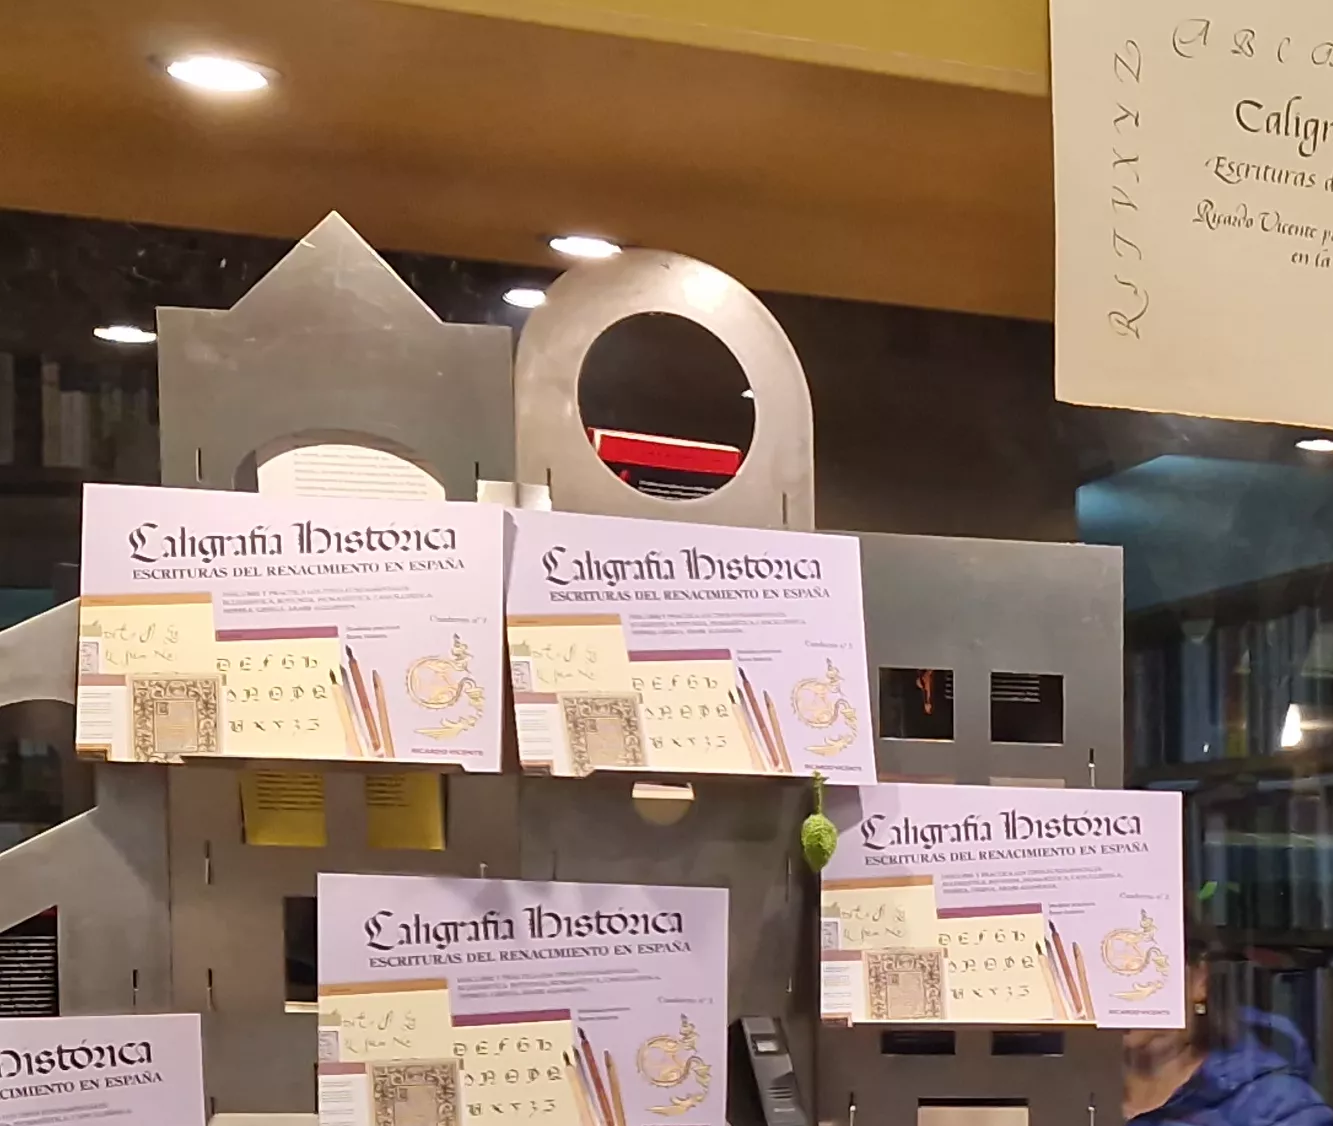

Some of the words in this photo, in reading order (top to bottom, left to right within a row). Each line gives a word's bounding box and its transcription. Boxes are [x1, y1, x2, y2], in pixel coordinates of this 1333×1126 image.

[1205, 157, 1316, 187] Escrituras
[1259, 211, 1317, 238] Vicente
[1291, 252, 1308, 264] en
[1314, 250, 1331, 268] la
[294, 519, 457, 556] Histórica
[133, 565, 228, 580] ESCRITURAS
[233, 565, 262, 579] DEL
[266, 561, 380, 577] RENACIMIENTO
[385, 561, 404, 573] EN
[409, 556, 465, 572] ESPAÑA
[681, 547, 821, 580] Histórica
[550, 589, 631, 602] ESCRITURAS
[635, 589, 660, 601] DEL
[664, 588, 759, 601] RENACIMIENTO
[763, 588, 779, 599] EN
[783, 585, 830, 600] ESPAÑA
[999, 808, 1141, 842] Histórica
[865, 851, 946, 867] ESCRITURAS
[950, 851, 975, 862] DEL
[979, 846, 1076, 861] RENACIMIENTO
[1080, 845, 1097, 856] EN
[1100, 841, 1149, 856] ESPAÑA
[523, 904, 683, 940] Histórica
[369, 952, 463, 968] ESCRITURAS
[466, 950, 495, 964] DEL
[499, 945, 609, 962] RENACIMIENTO
[613, 944, 633, 956] EN
[637, 939, 691, 955] ESPAÑA
[80, 1078, 100, 1092] EN
[105, 1071, 164, 1089] ESPAÑA
